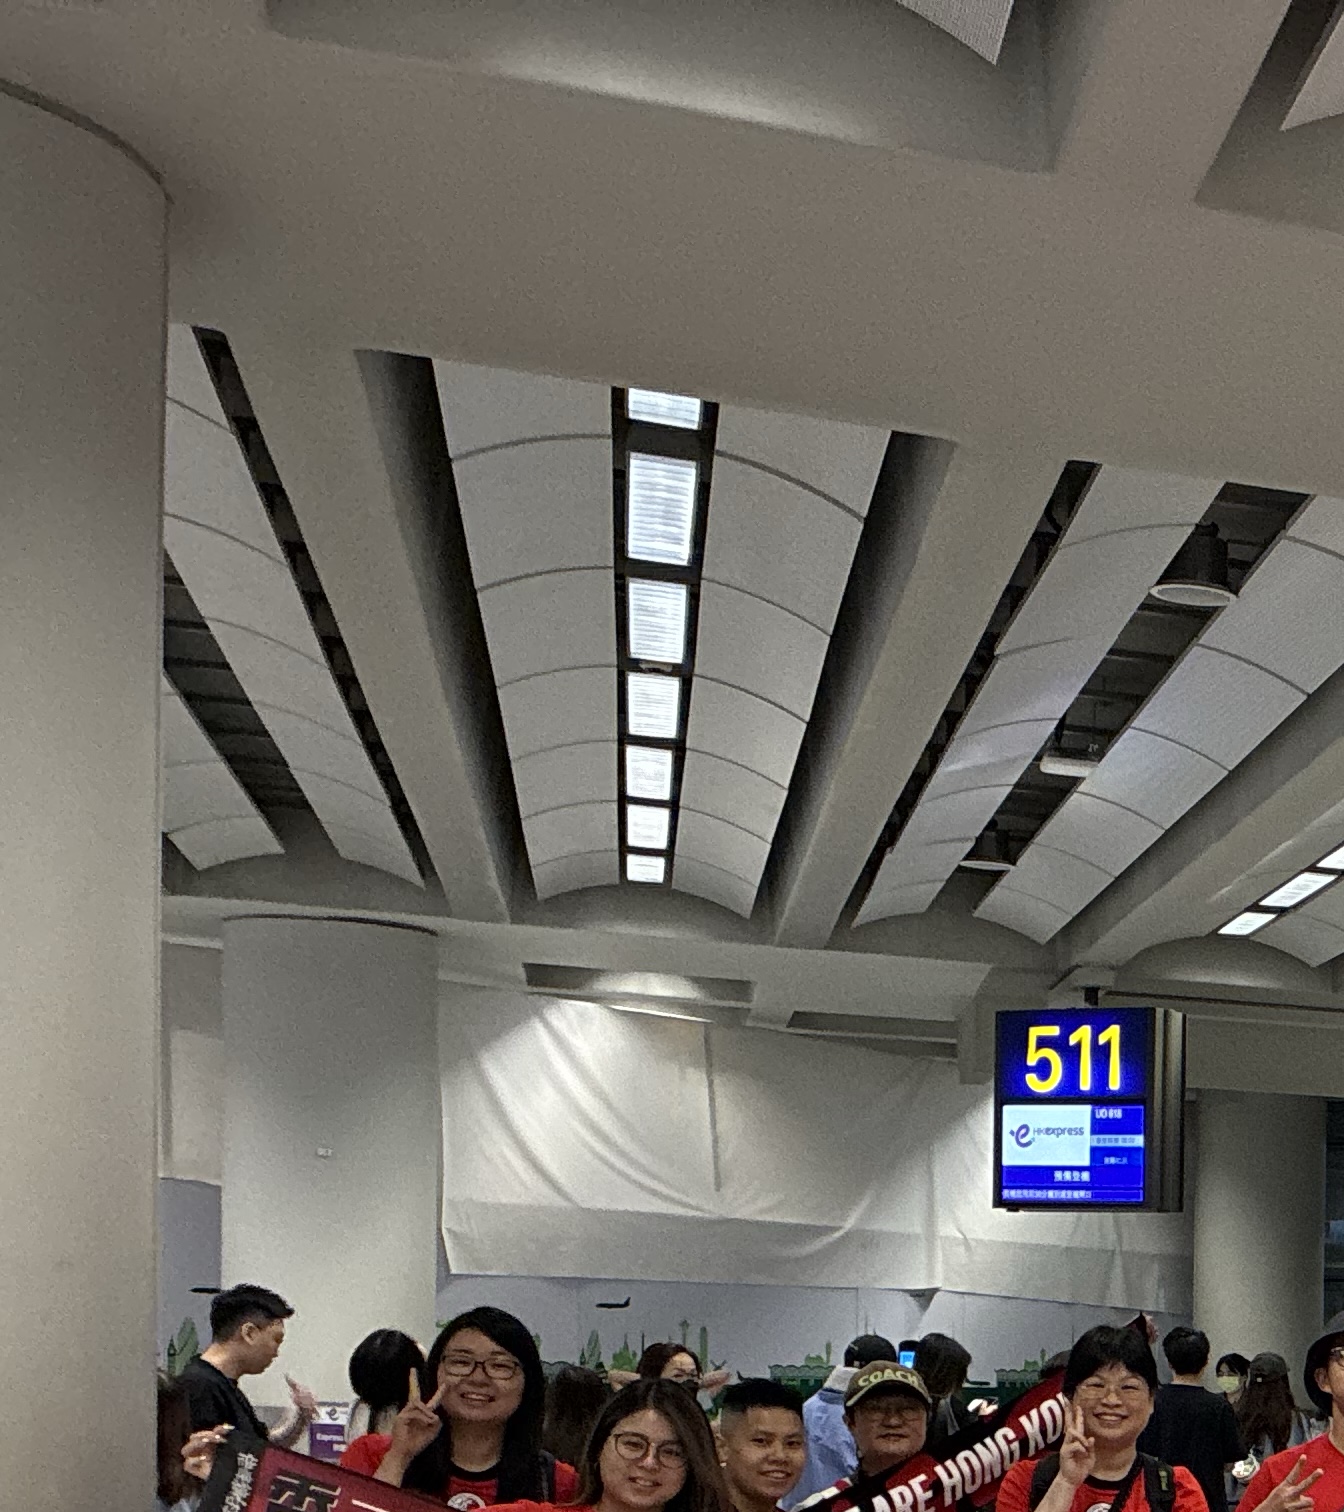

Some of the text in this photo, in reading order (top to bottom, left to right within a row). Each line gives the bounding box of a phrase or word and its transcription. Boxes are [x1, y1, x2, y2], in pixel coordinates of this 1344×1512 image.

[1025, 1024, 1121, 1092] 511
[857, 1368, 920, 1388] COACH
[933, 1426, 1021, 1508] HONG
[1019, 1391, 1073, 1458] KO
